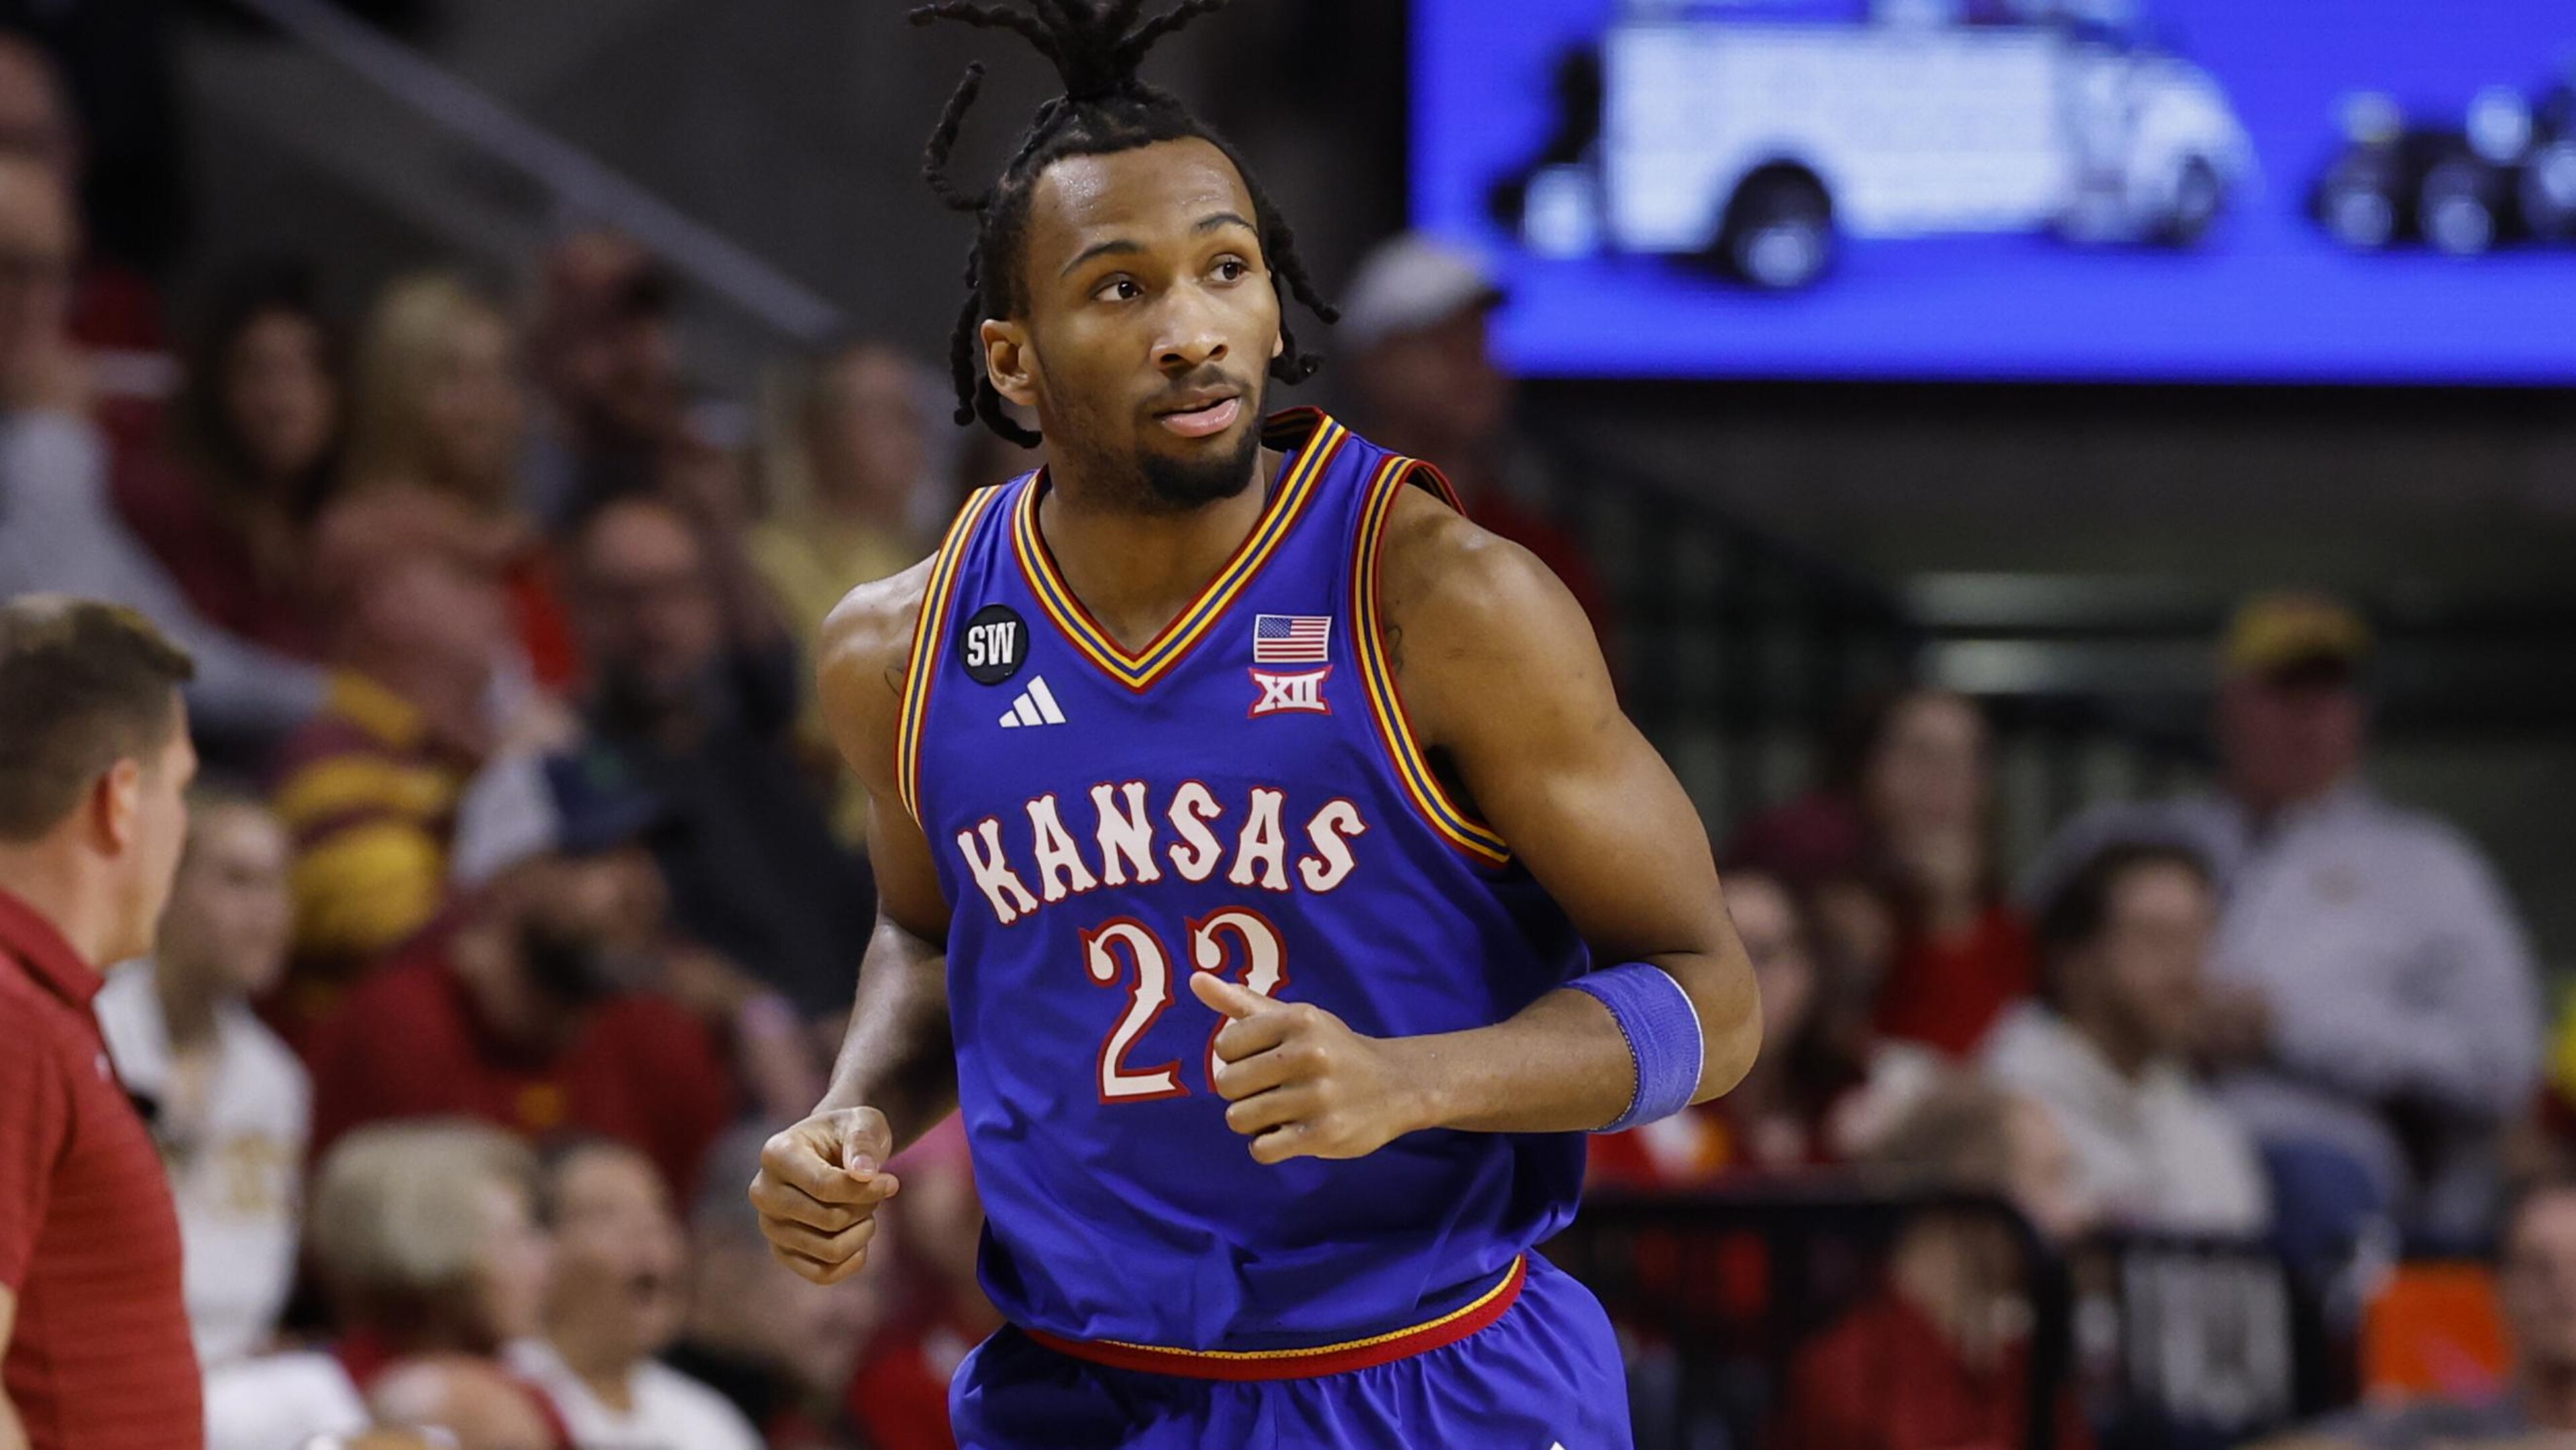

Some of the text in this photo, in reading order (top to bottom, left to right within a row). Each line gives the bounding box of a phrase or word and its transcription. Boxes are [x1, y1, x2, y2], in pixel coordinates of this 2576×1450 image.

[967, 621, 1016, 667] SW
[1251, 667, 1328, 716] XII
[955, 780, 1370, 925] KANSAS
